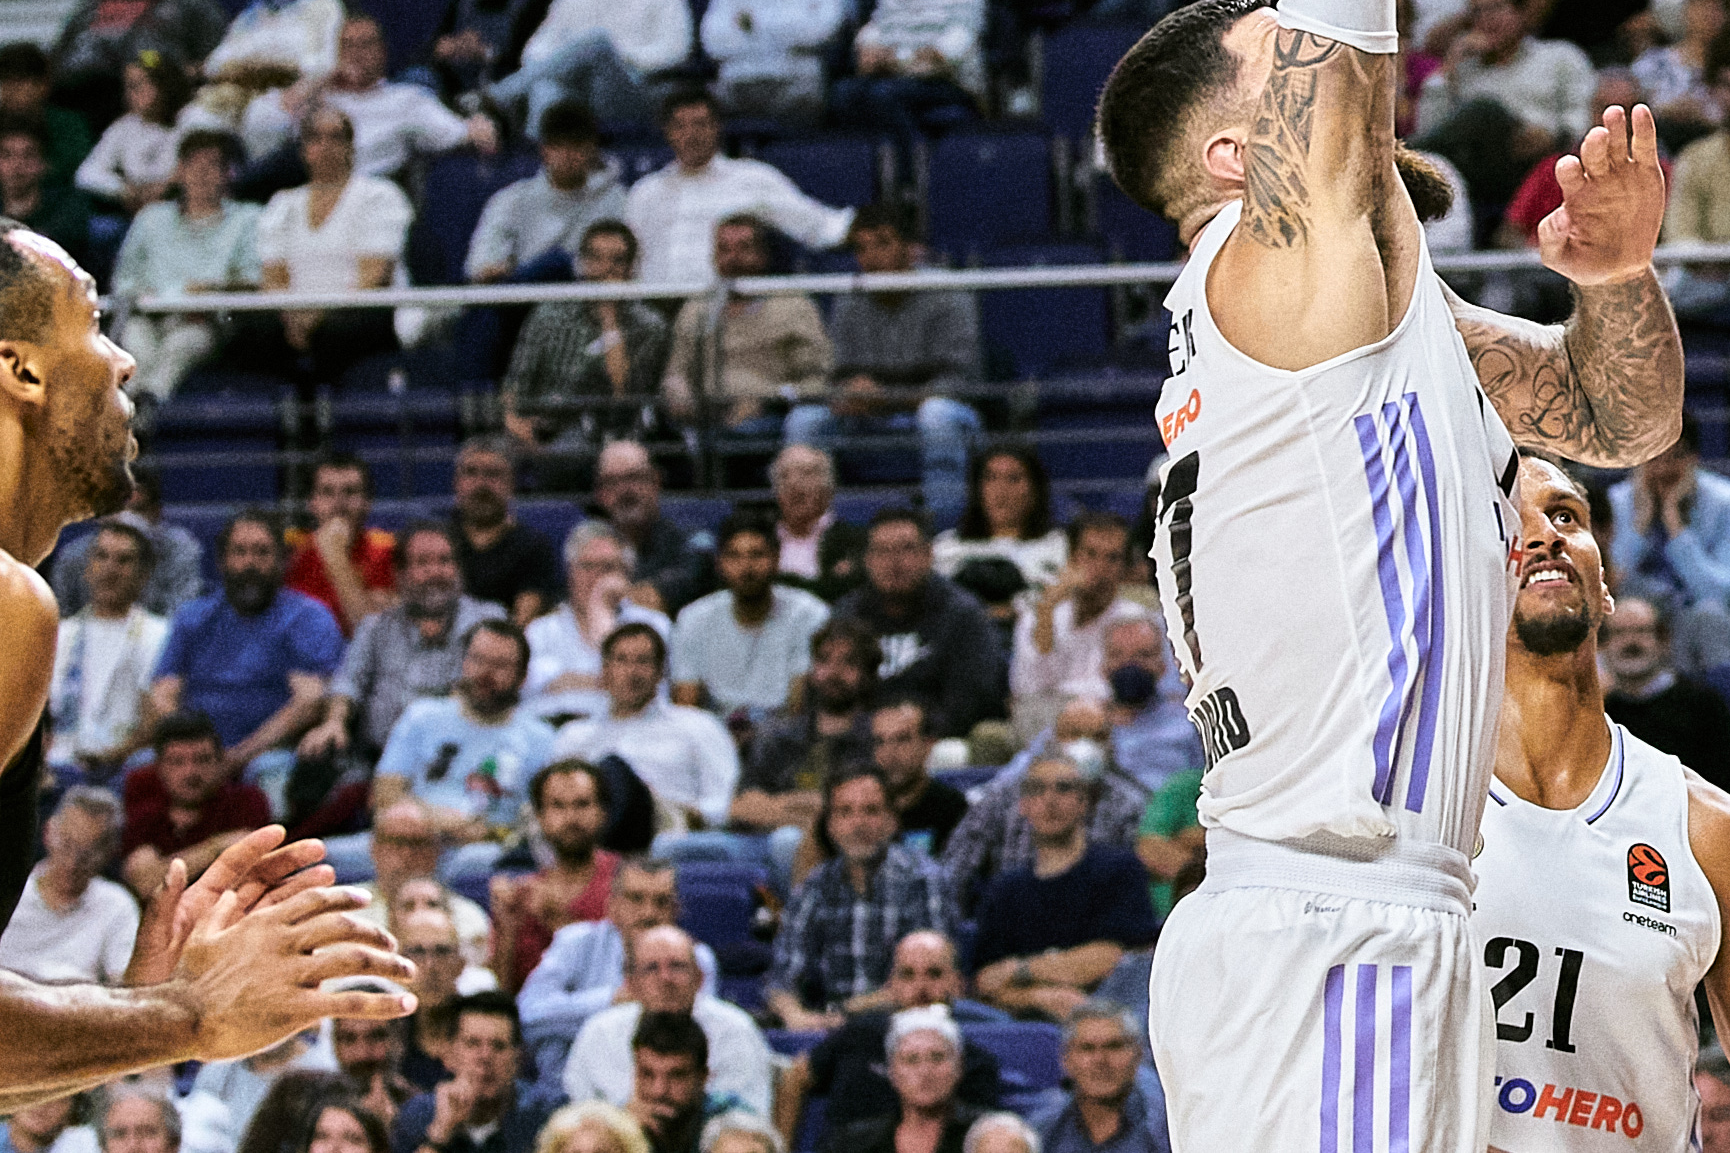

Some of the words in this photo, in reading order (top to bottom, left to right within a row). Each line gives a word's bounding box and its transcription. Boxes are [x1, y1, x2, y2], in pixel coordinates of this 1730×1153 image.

[1622, 911, 1677, 937] oneteam
[1484, 936, 1584, 1053] 21
[1494, 1076, 1644, 1139] OHERO
